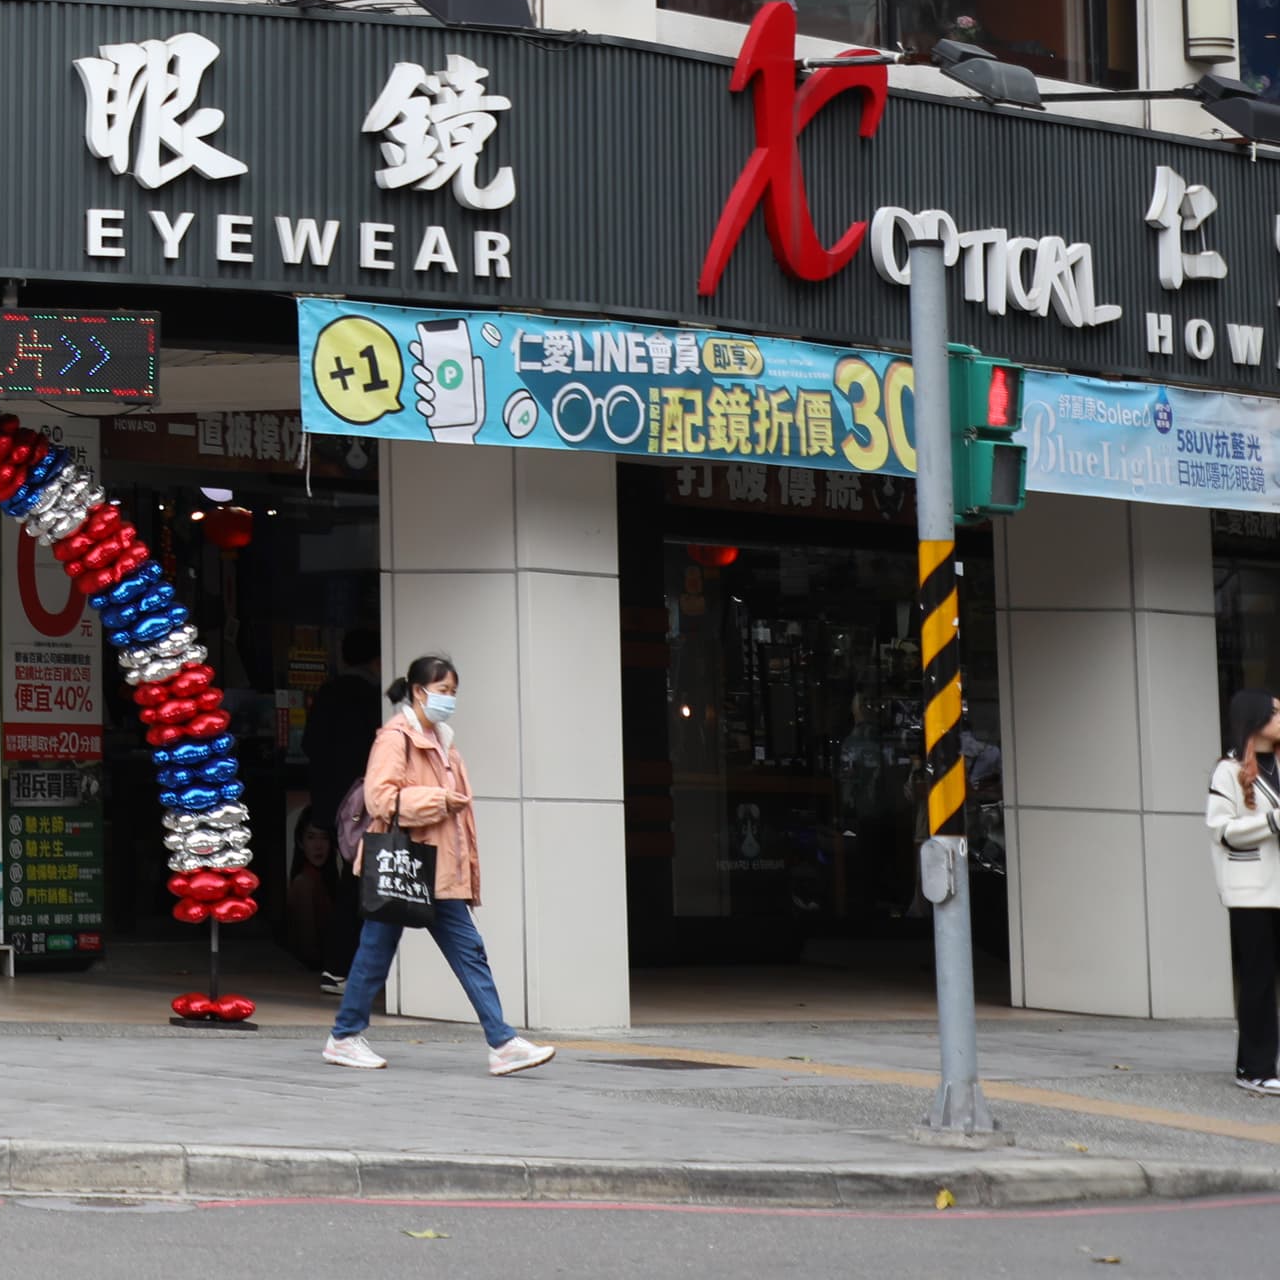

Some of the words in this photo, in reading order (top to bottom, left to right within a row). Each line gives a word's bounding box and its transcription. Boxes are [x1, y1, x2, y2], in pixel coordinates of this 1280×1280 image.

[85, 208, 513, 279] EYEWEAR
[1144, 166, 1280, 291] 仁
[510, 327, 703, 375] 仁愛LINE會員
[712, 343, 748, 370] 即享
[1146, 312, 1280, 370] HOW
[328, 344, 390, 393] +1
[660, 385, 836, 457] 配鏡折價
[1176, 428, 1263, 462] 58UV抗藍光
[1176, 459, 1268, 495] 日拋隱形眼鏡
[14, 683, 94, 713] 便宜40%
[15, 772, 81, 799] 招兵買馬
